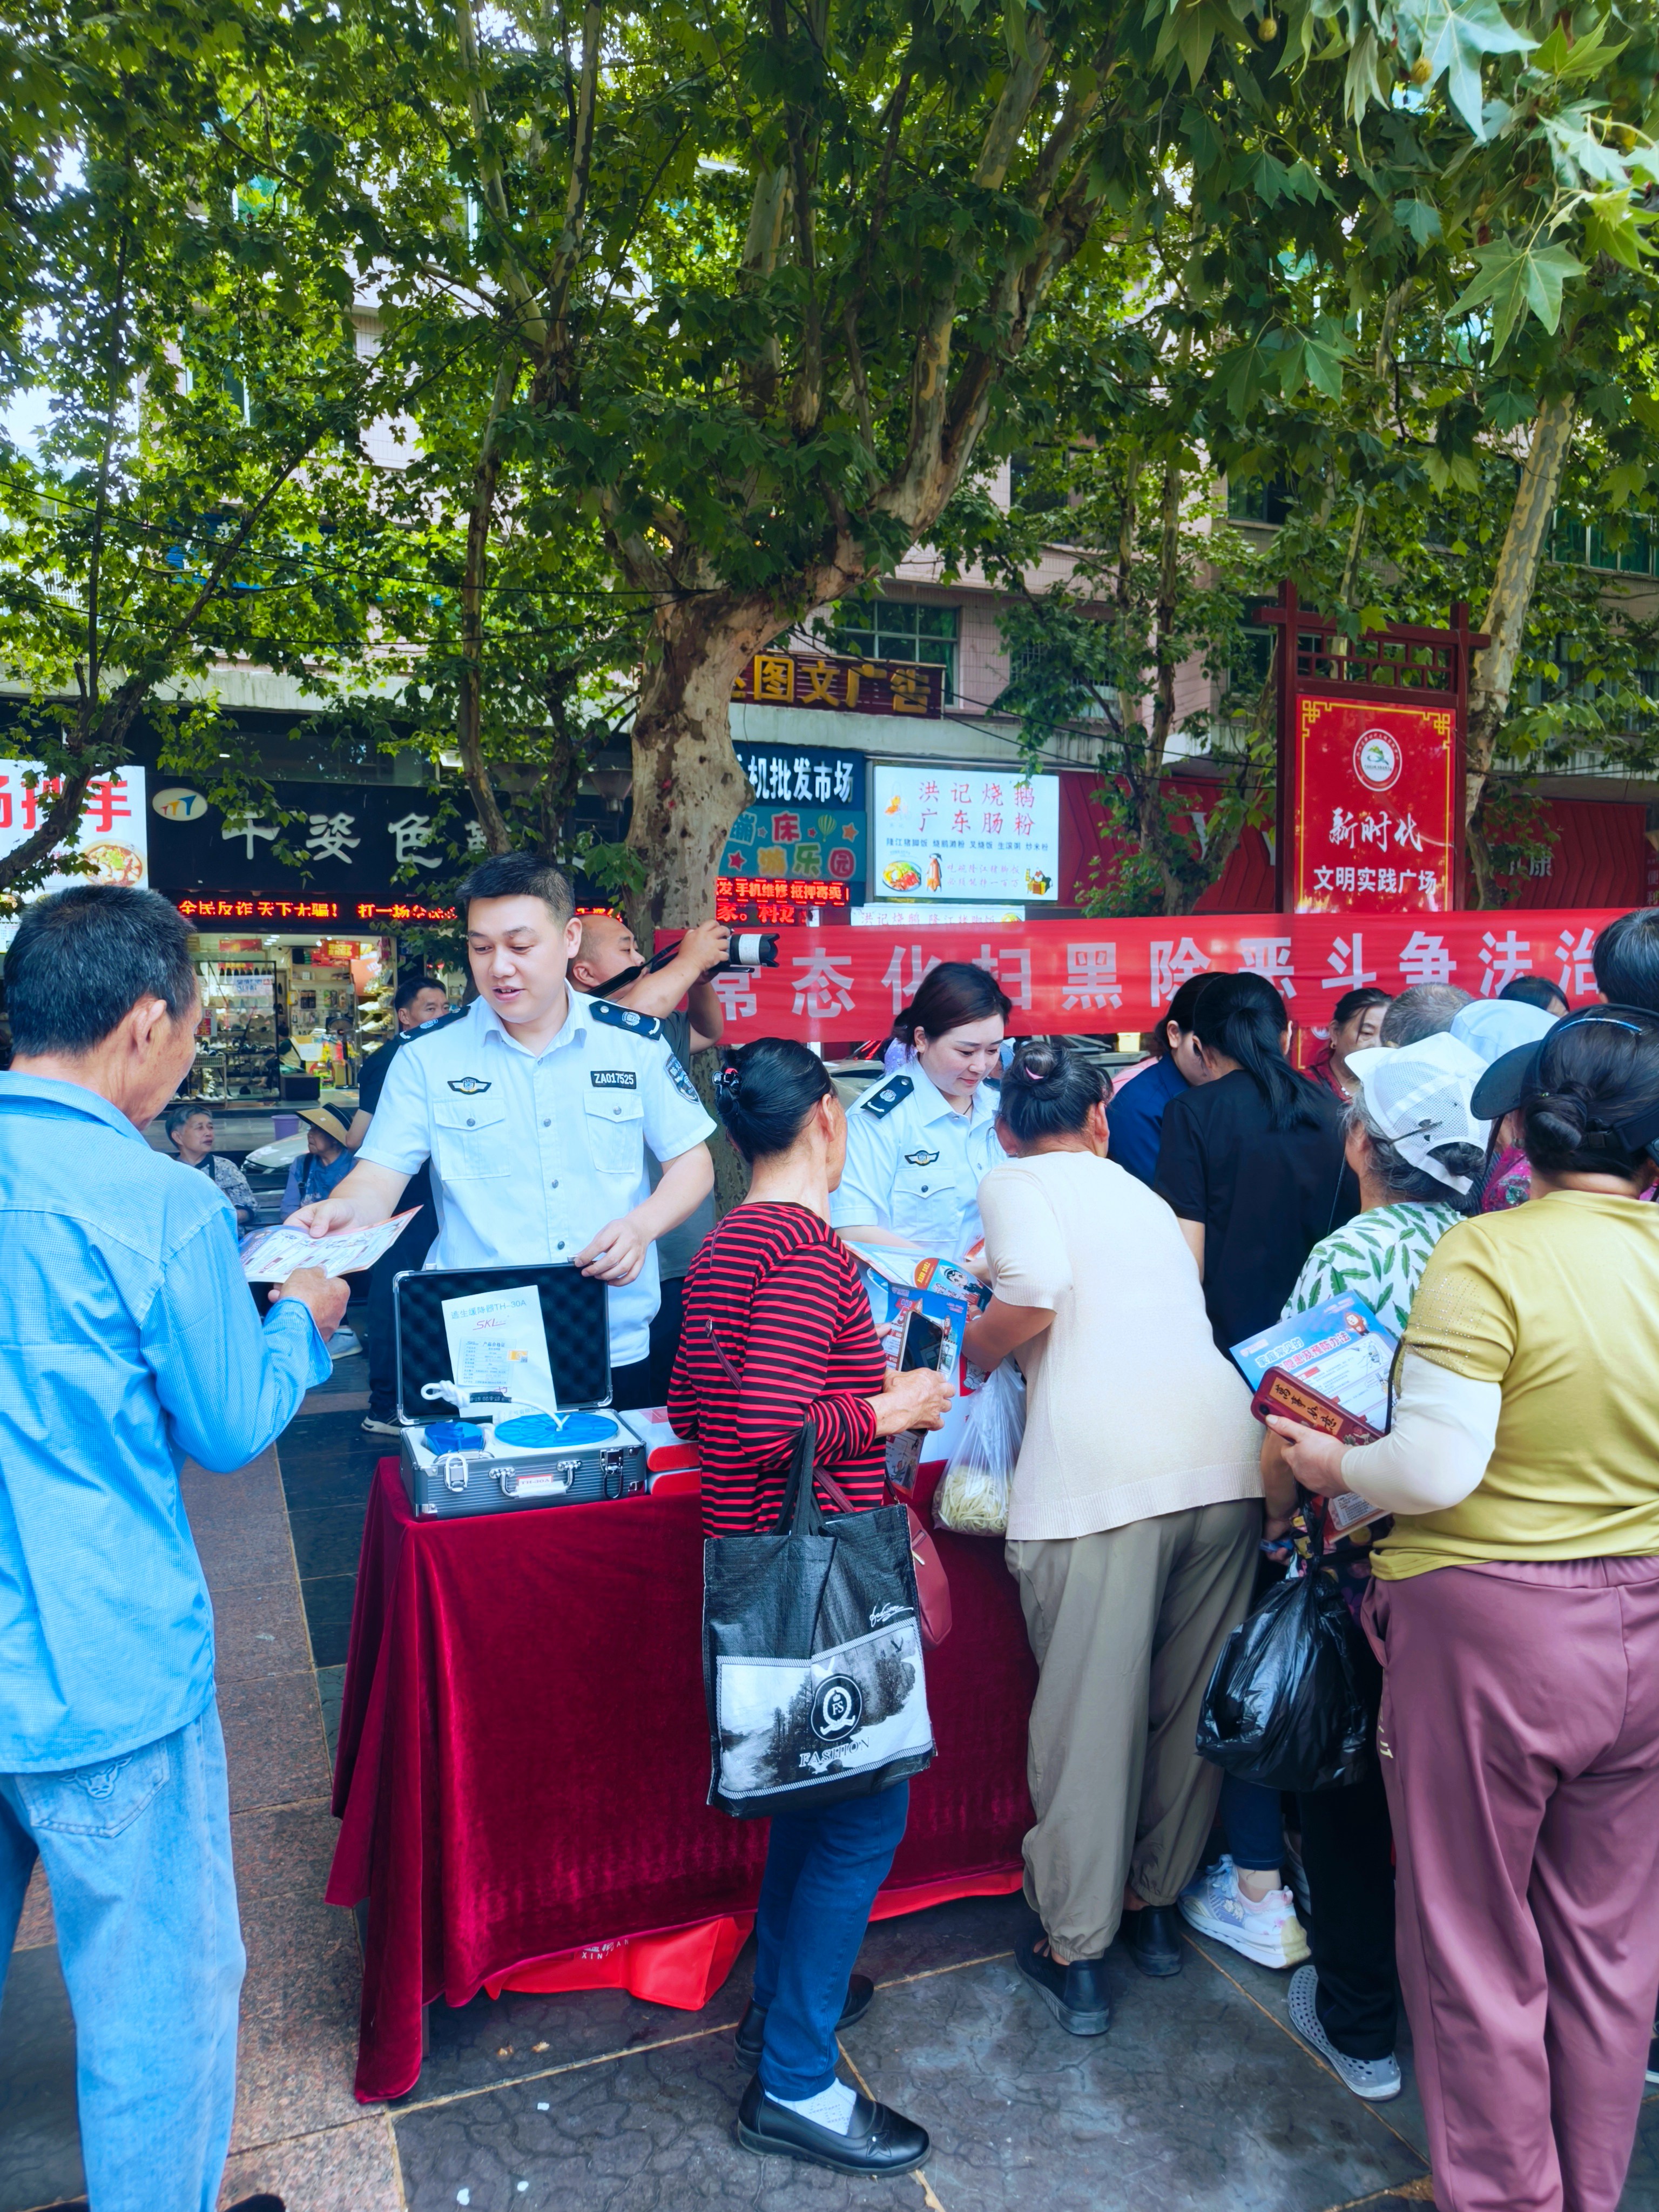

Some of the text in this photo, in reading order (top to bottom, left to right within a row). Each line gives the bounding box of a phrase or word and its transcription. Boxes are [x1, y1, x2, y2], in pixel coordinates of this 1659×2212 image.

[738, 754, 853, 803] 机批发市场
[919, 780, 1035, 809] 洪记烧鹅
[919, 809, 1035, 836] 广东肠粉
[1329, 807, 1423, 853] 新时代
[736, 882, 788, 898] 手机维修
[791, 884, 842, 900] 抵押寄卖
[1313, 865, 1437, 895] 文明实践广场
[594, 1073, 634, 1085] ZA017525
[832, 1701, 844, 1715] FS
[799, 1737, 870, 1768] FASHION
